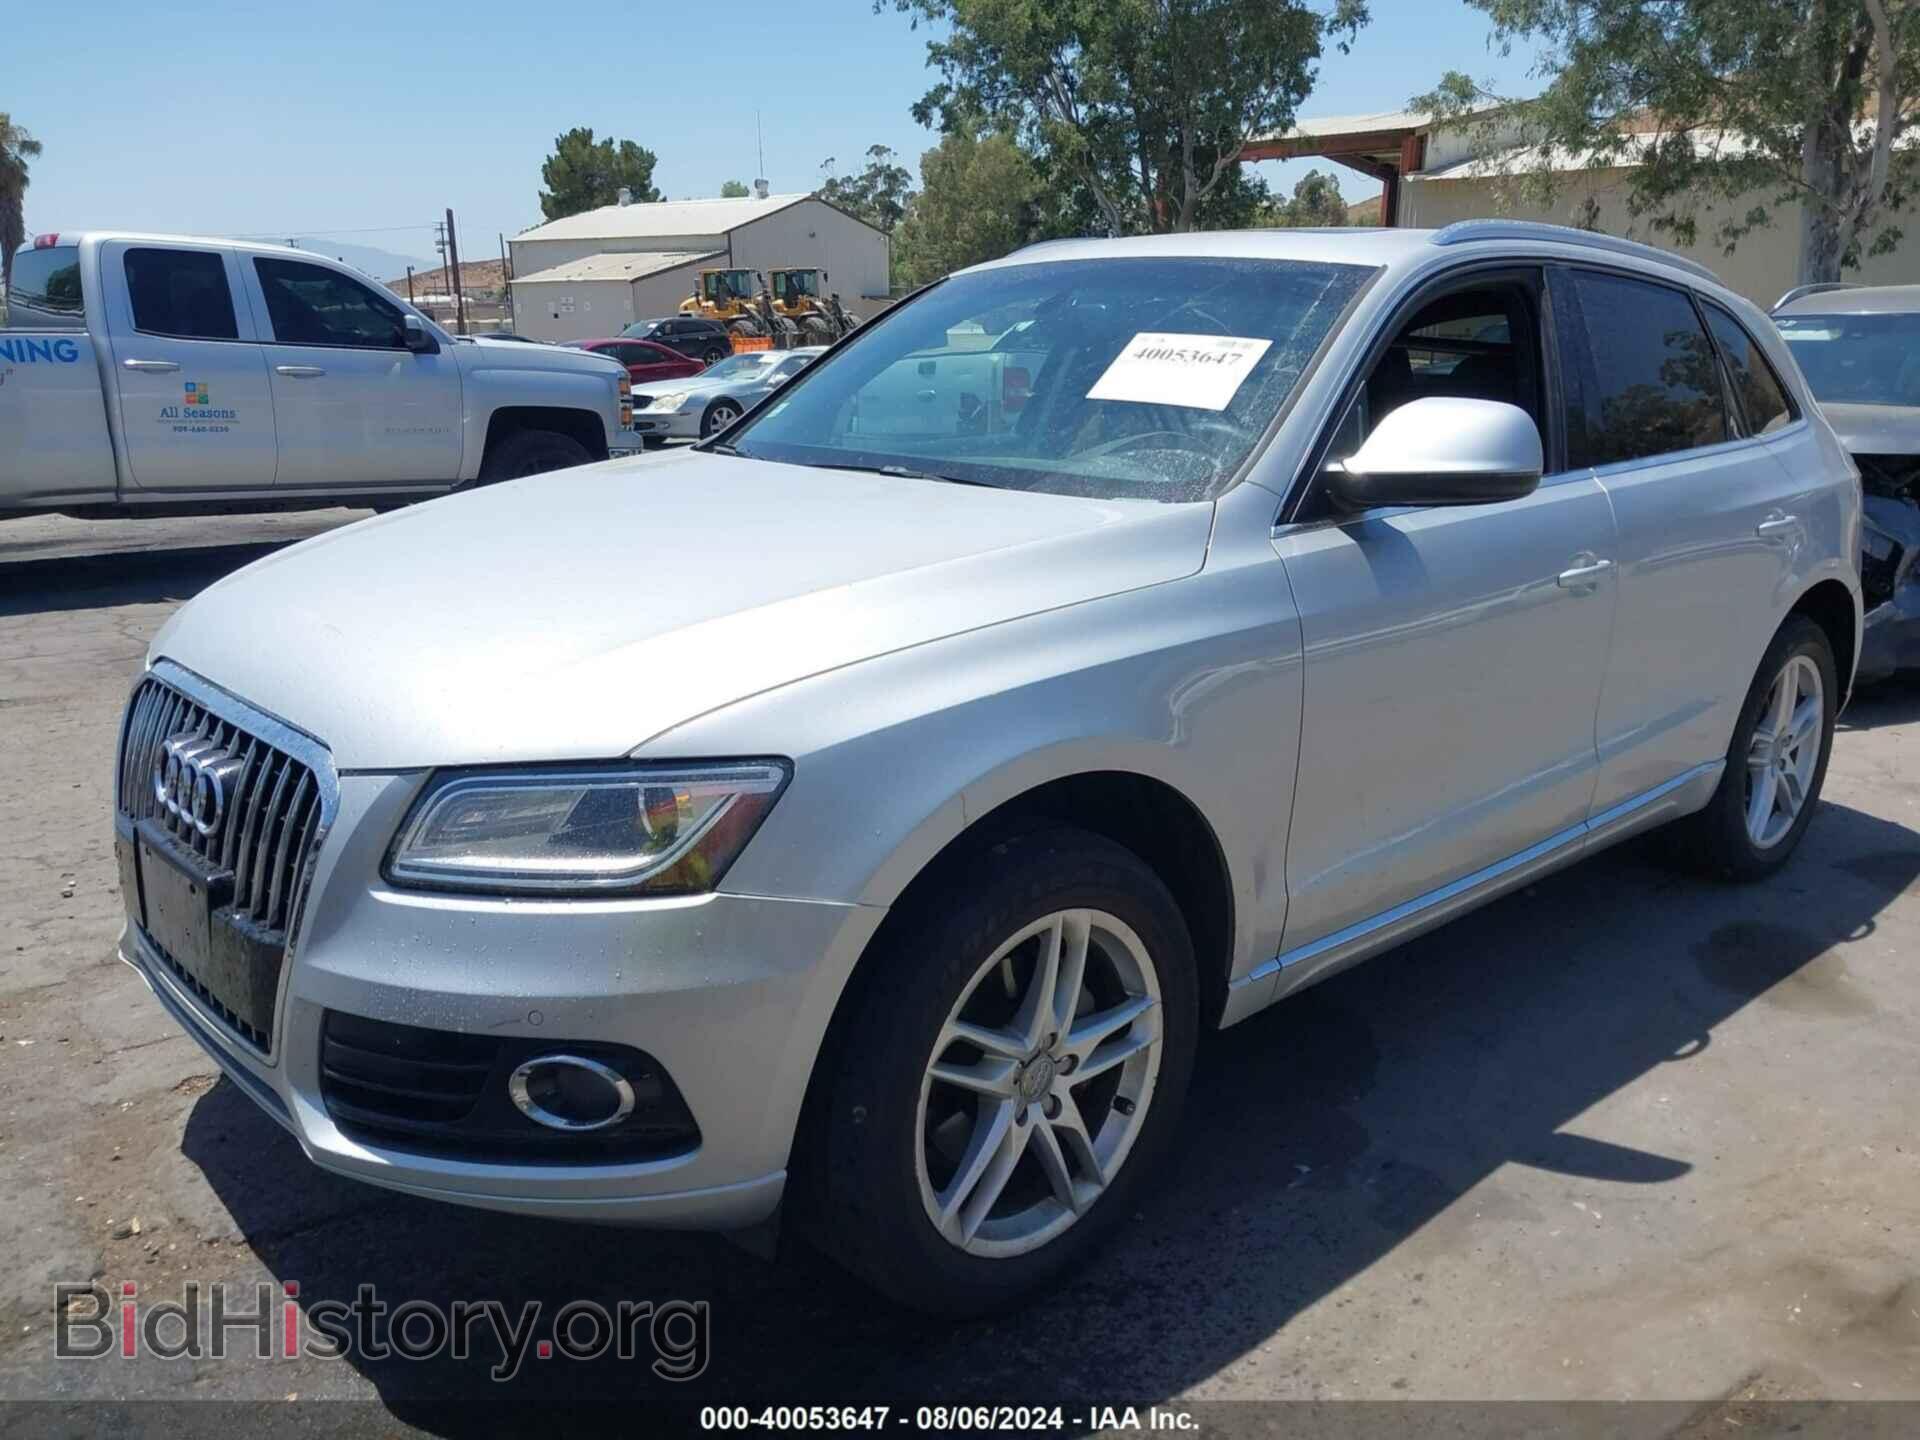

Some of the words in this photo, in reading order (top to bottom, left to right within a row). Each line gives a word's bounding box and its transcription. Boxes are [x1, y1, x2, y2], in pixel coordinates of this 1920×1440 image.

[1133, 347, 1243, 366] 40053647
[160, 406, 178, 418] All
[183, 407, 236, 418] Seasons
